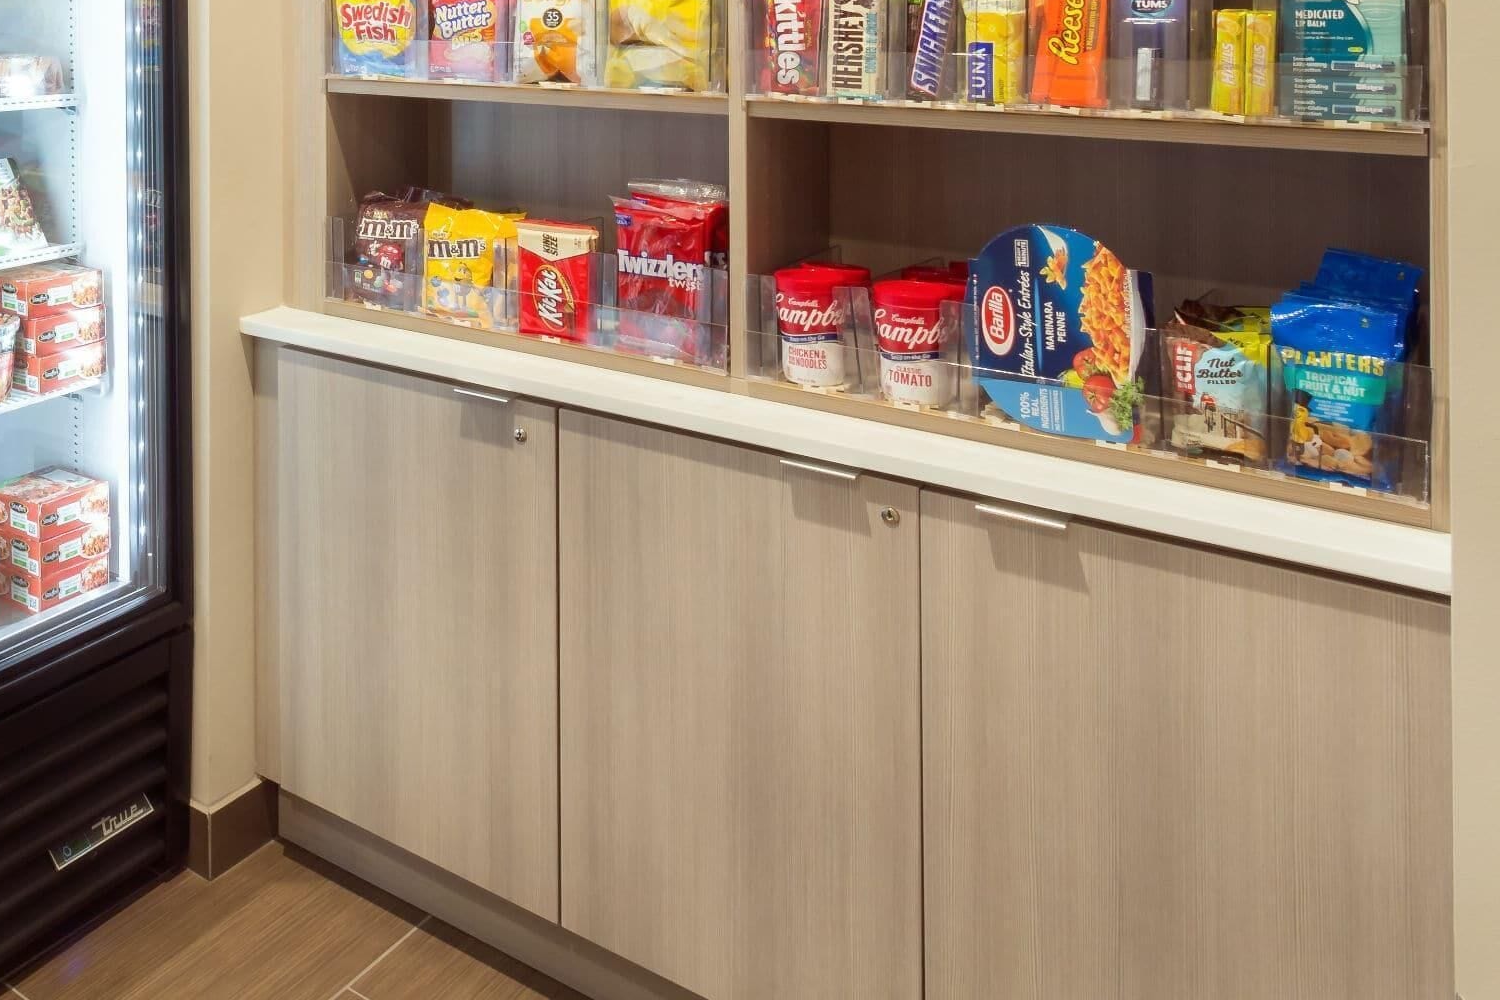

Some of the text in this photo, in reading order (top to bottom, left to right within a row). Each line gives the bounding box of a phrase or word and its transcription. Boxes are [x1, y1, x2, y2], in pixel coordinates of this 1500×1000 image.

[340, 2, 412, 28] Swedish
[436, 0, 487, 22] Nutter
[1135, 0, 1168, 9] TUMS
[1295, 9, 1344, 20] MEDICATED
[441, 12, 492, 37] Butter
[545, 11, 560, 22] 35
[1295, 19, 1326, 28] LIP BALM
[354, 21, 397, 43] Fish
[972, 46, 987, 99] LUNA
[1221, 43, 1236, 86] HALLS
[1254, 44, 1268, 88] HALLS
[428, 239, 486, 259] m&m's
[542, 233, 551, 254] KING
[550, 233, 559, 256] SIZE
[618, 249, 704, 281] Twizzlers
[990, 292, 1005, 340] Barilla
[1017, 270, 1039, 377] Italian-Style Entrées
[1045, 302, 1055, 351] MARINARA
[1057, 311, 1066, 343] PENNE
[789, 347, 826, 359] CHICKEN &
[796, 358, 827, 370] NOODLES
[1176, 346, 1193, 381] CLIF
[1207, 356, 1236, 368] Nut
[1281, 346, 1385, 376] PLANTERS
[889, 369, 933, 388] TOMATO
[1197, 368, 1244, 379] Butter
[1305, 371, 1359, 387] TROPICAL
[1300, 380, 1365, 398] FRUIT & NUT
[1021, 392, 1031, 419] 100%
[1031, 400, 1039, 417] REAL
[1040, 388, 1048, 429] INGREDIENTS
